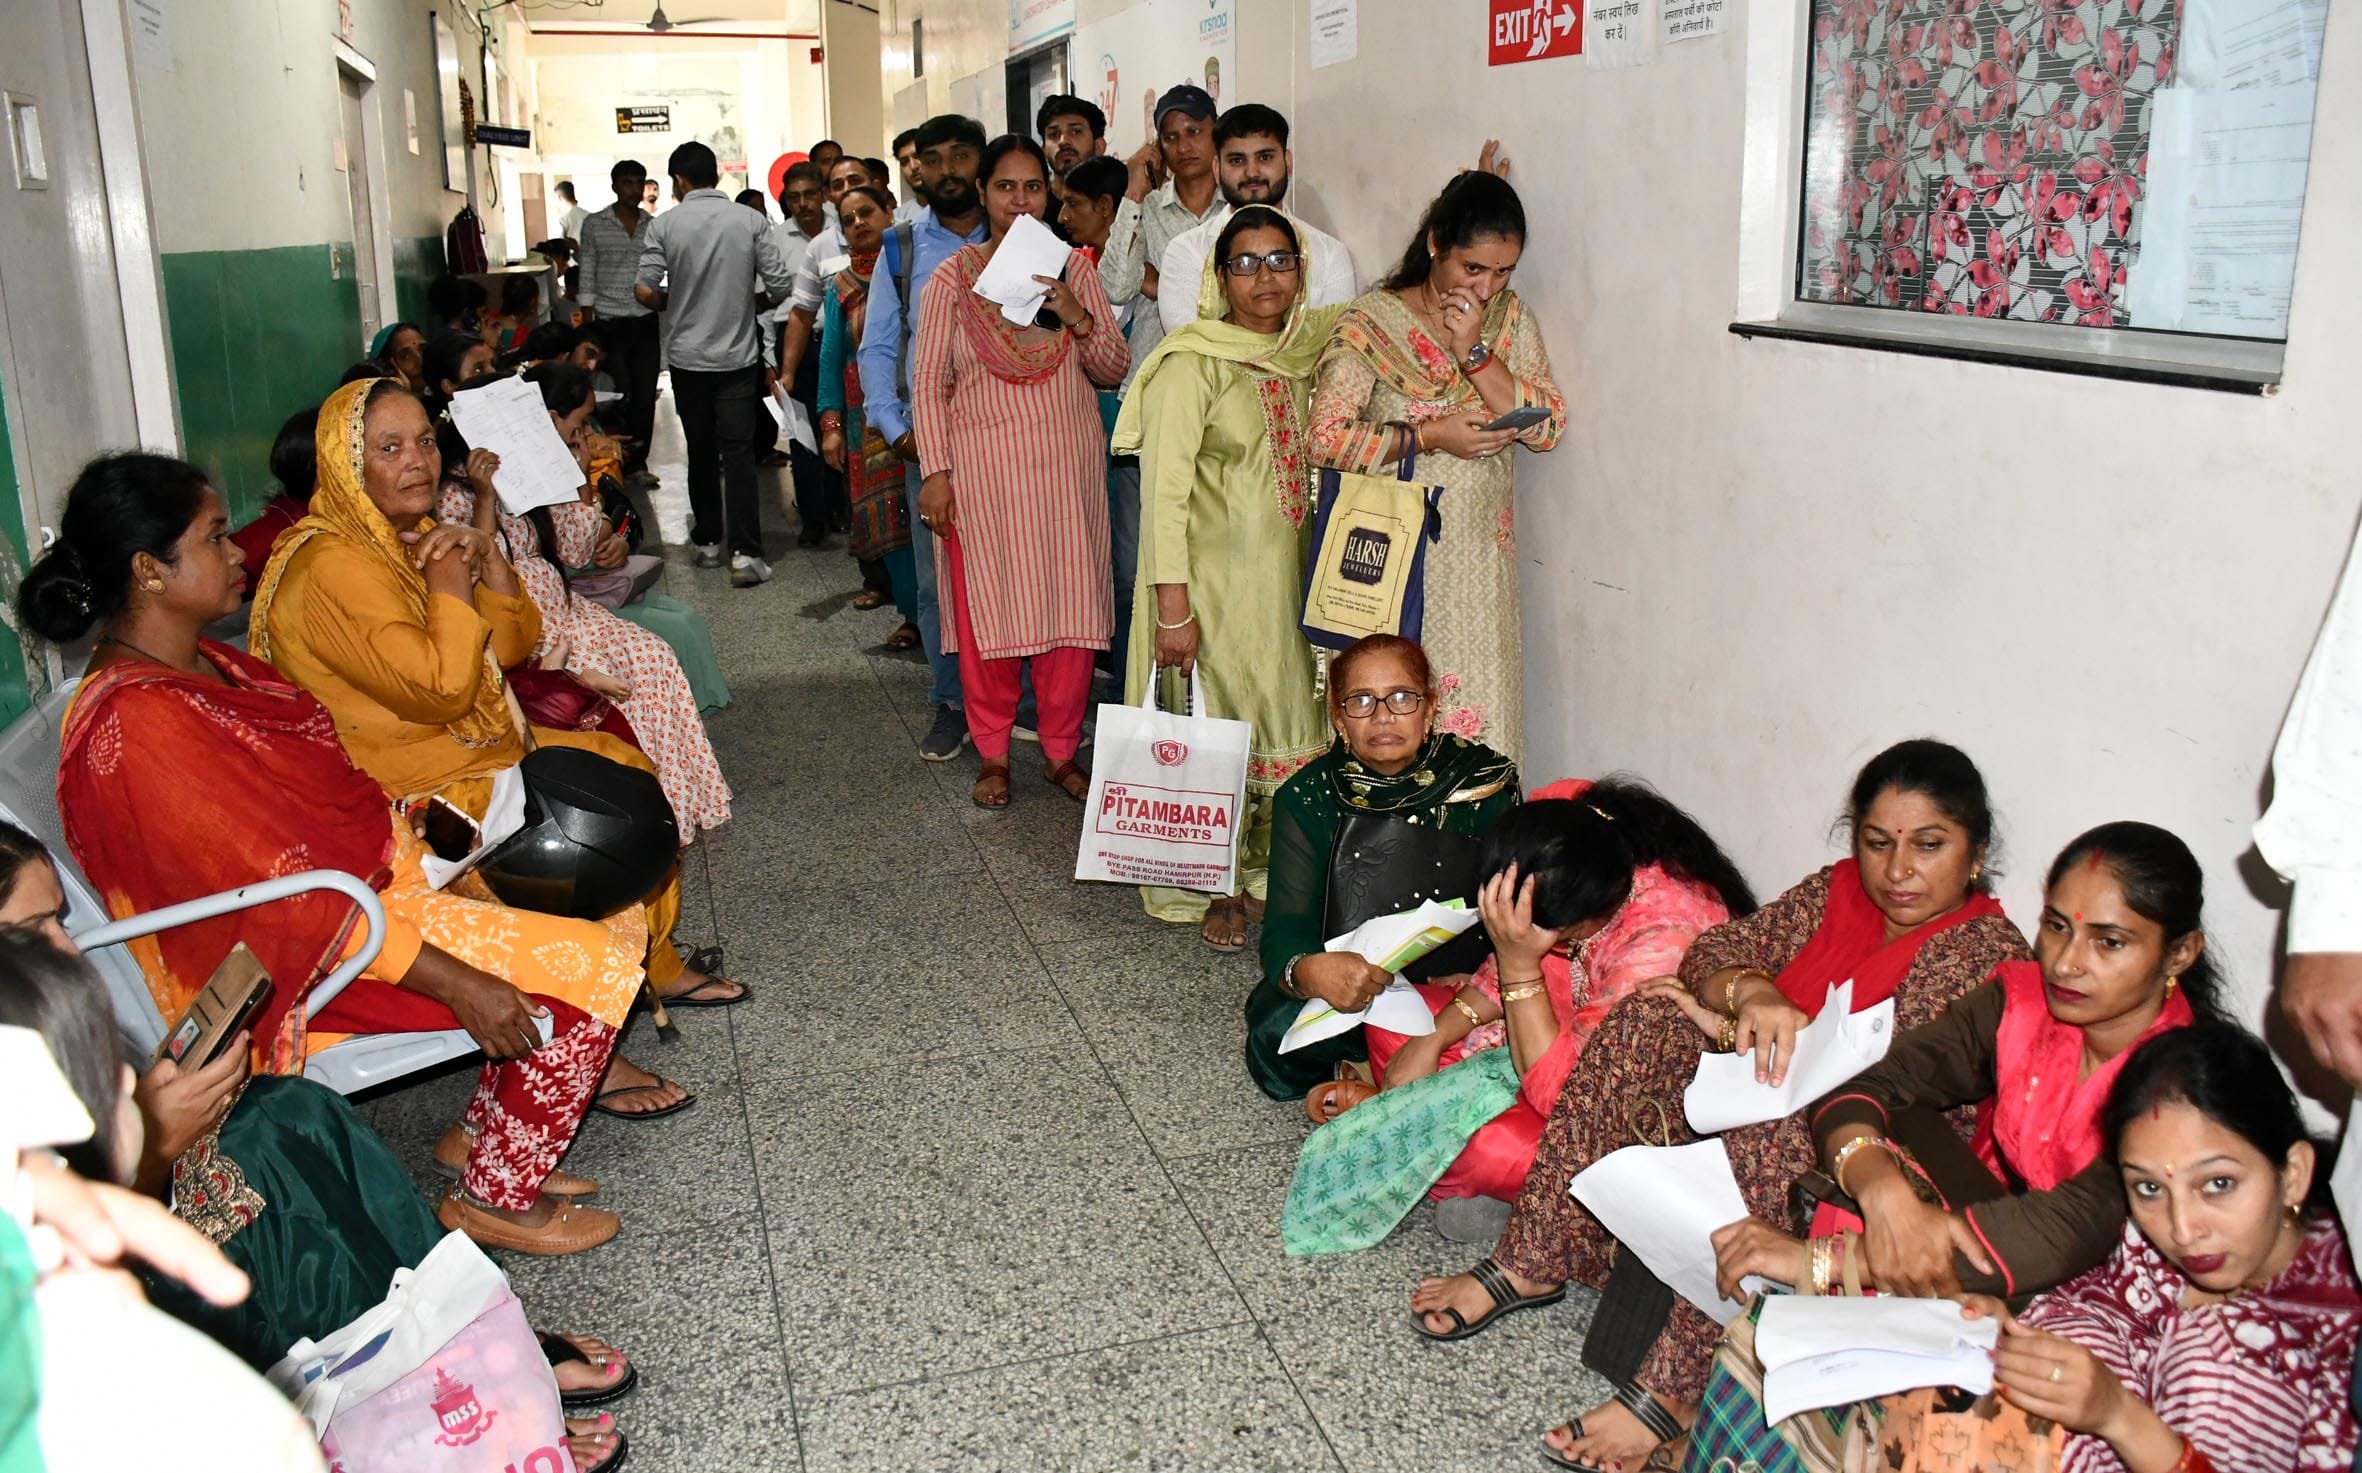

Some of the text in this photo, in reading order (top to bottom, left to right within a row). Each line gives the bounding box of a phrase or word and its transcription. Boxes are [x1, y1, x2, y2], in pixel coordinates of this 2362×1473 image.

[1496, 8, 1531, 46] EXIT
[632, 124, 670, 132] TOILETS
[1345, 536, 1388, 568] HARSH
[1161, 745, 1176, 759] PG
[1108, 786, 1128, 796] श्री
[1102, 795, 1228, 828] PITAMBARA
[1115, 820, 1212, 841] GARMENTS
[1122, 864, 1141, 872] PASS
[1142, 867, 1163, 876] ROAD
[1164, 870, 1202, 879] HAMIRPUR
[442, 1401, 479, 1429] mss
